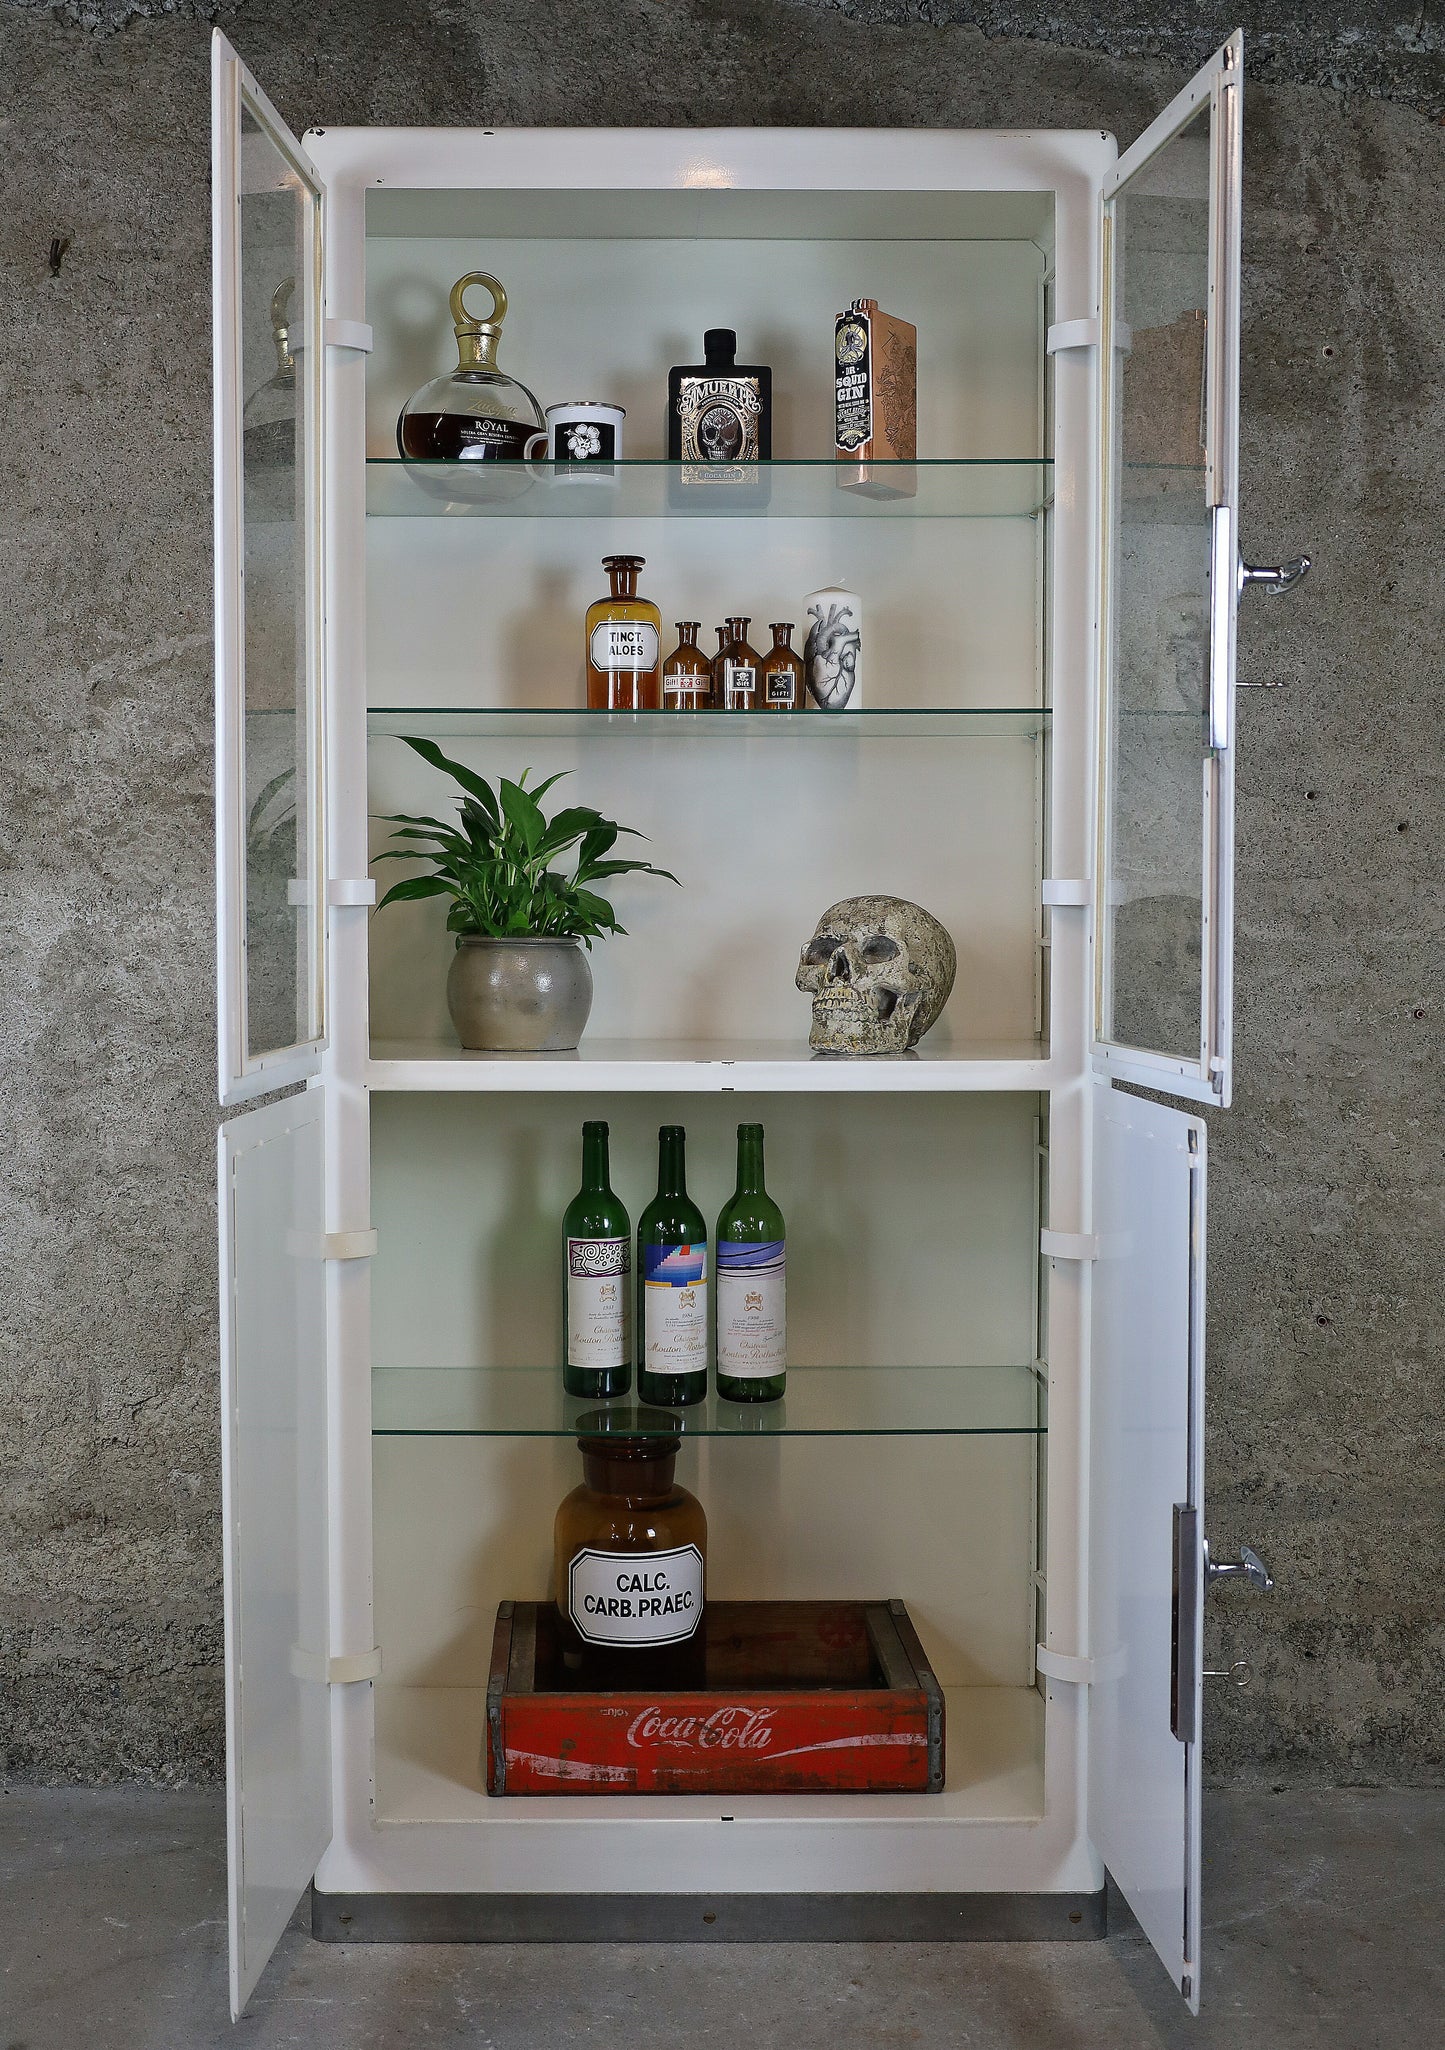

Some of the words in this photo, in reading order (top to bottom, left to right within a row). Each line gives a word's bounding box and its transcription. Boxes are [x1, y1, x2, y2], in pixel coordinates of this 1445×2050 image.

[836, 372, 867, 388] SQUID
[837, 385, 865, 402] GIN
[474, 420, 509, 432] ROYAL
[610, 632, 644, 643] TINCT.
[608, 645, 644, 656] ALOES
[648, 1342, 682, 1353] Mouton
[616, 1572, 670, 1592] CALC.
[626, 1706, 778, 1748] Coca-Cola
